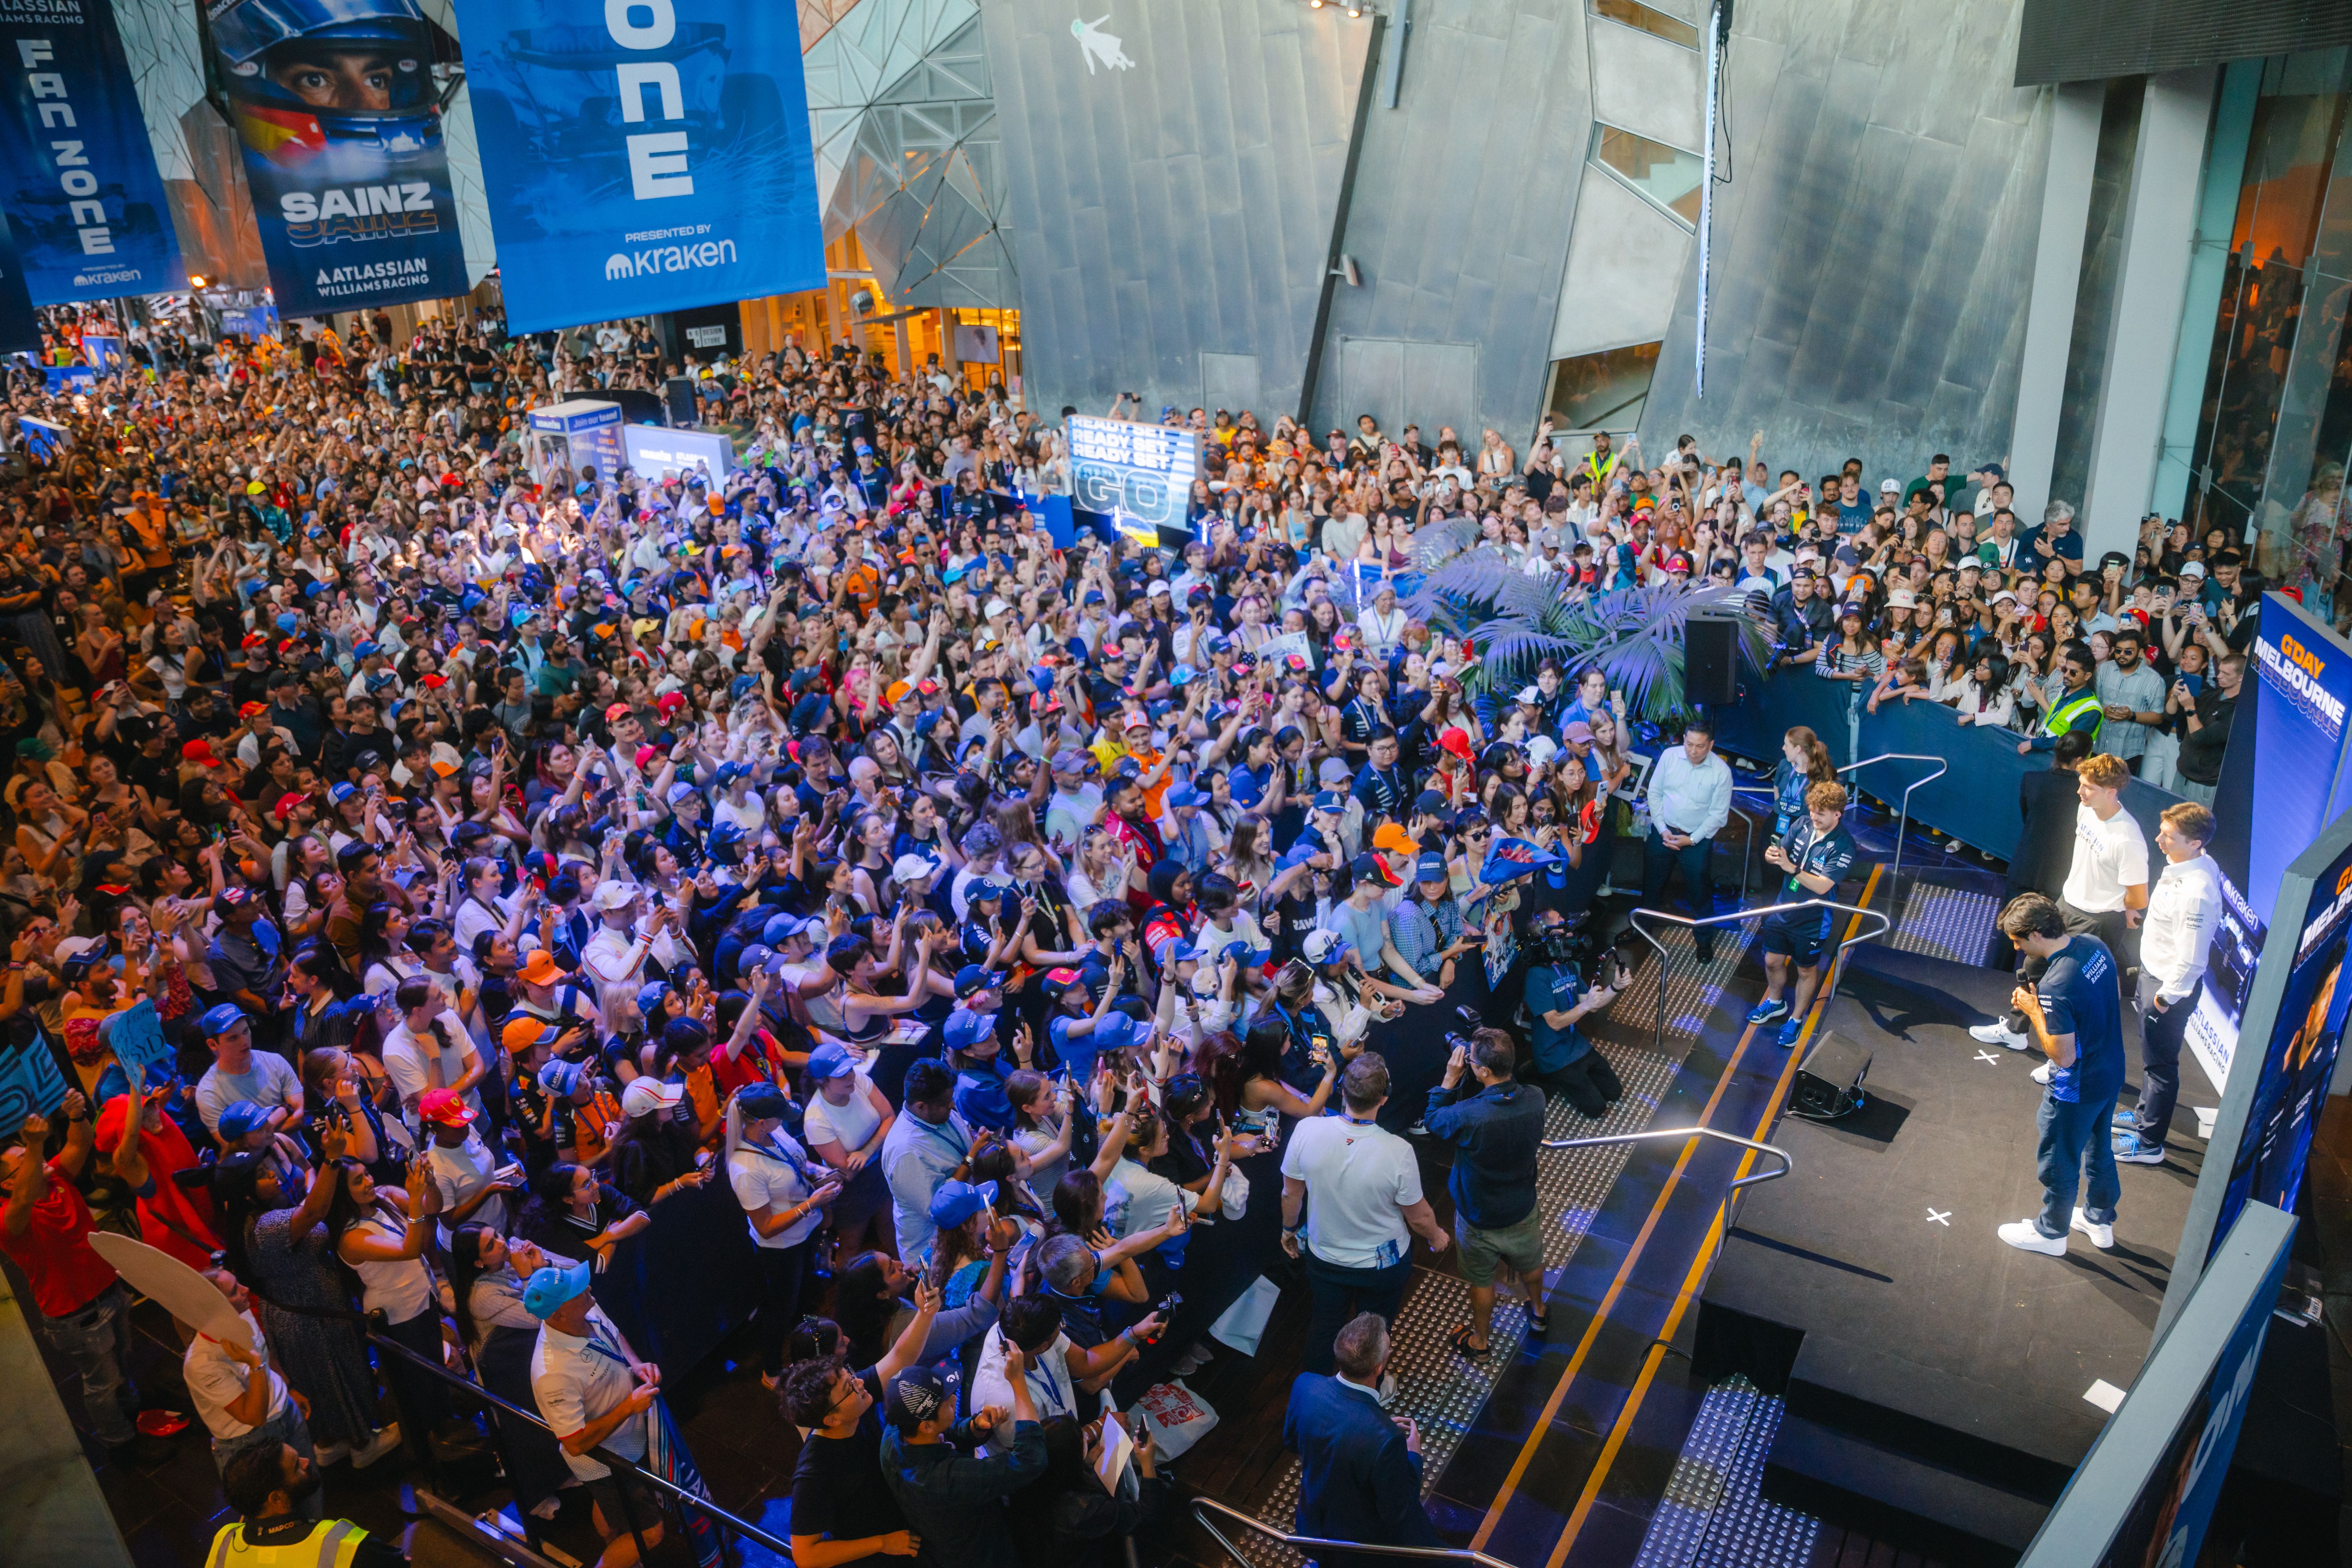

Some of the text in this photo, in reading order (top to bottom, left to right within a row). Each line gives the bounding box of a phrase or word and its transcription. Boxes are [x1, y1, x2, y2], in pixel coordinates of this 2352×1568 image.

[281, 182, 434, 223] SAINZ
[625, 224, 711, 243] PRESENTED BY
[333, 258, 427, 283] ATLASSIAN
[1072, 428, 1169, 455] READY SET
[1073, 443, 1170, 470] READY SET
[1074, 461, 1172, 523] GO
[2281, 634, 2325, 680] G'DAY
[2254, 635, 2346, 726] MELBOURNE
[2082, 949, 2101, 974] ATLASSIAN
[2085, 955, 2106, 980] WILLIAMS
[2091, 963, 2107, 984] RACING
[2189, 1014, 2207, 1046] ILLIAMS
[2194, 1005, 2230, 1064] ATLASSIAN
